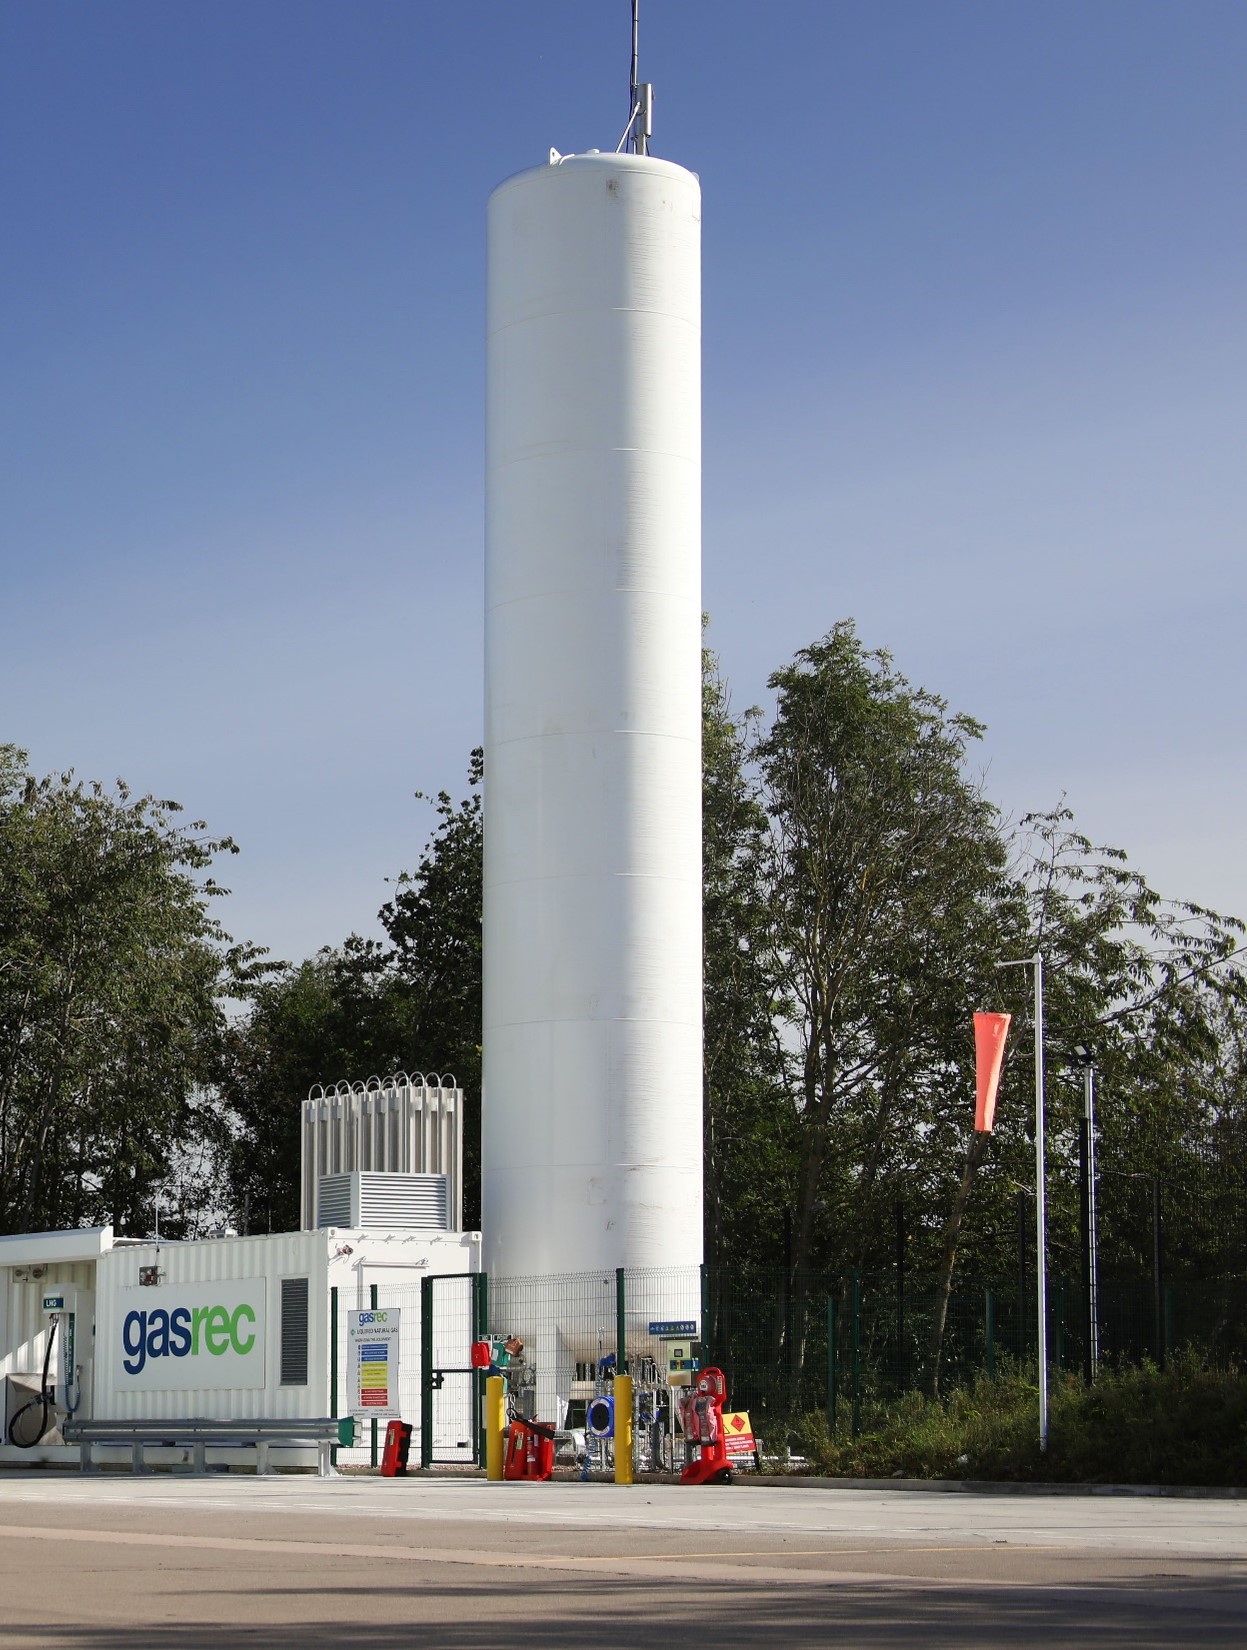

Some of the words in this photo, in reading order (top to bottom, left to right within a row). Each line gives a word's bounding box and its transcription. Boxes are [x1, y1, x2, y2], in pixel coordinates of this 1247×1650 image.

[46, 1299, 57, 1307] LNG
[358, 1312, 388, 1326] gasrec
[123, 1304, 256, 1375] gasrec
